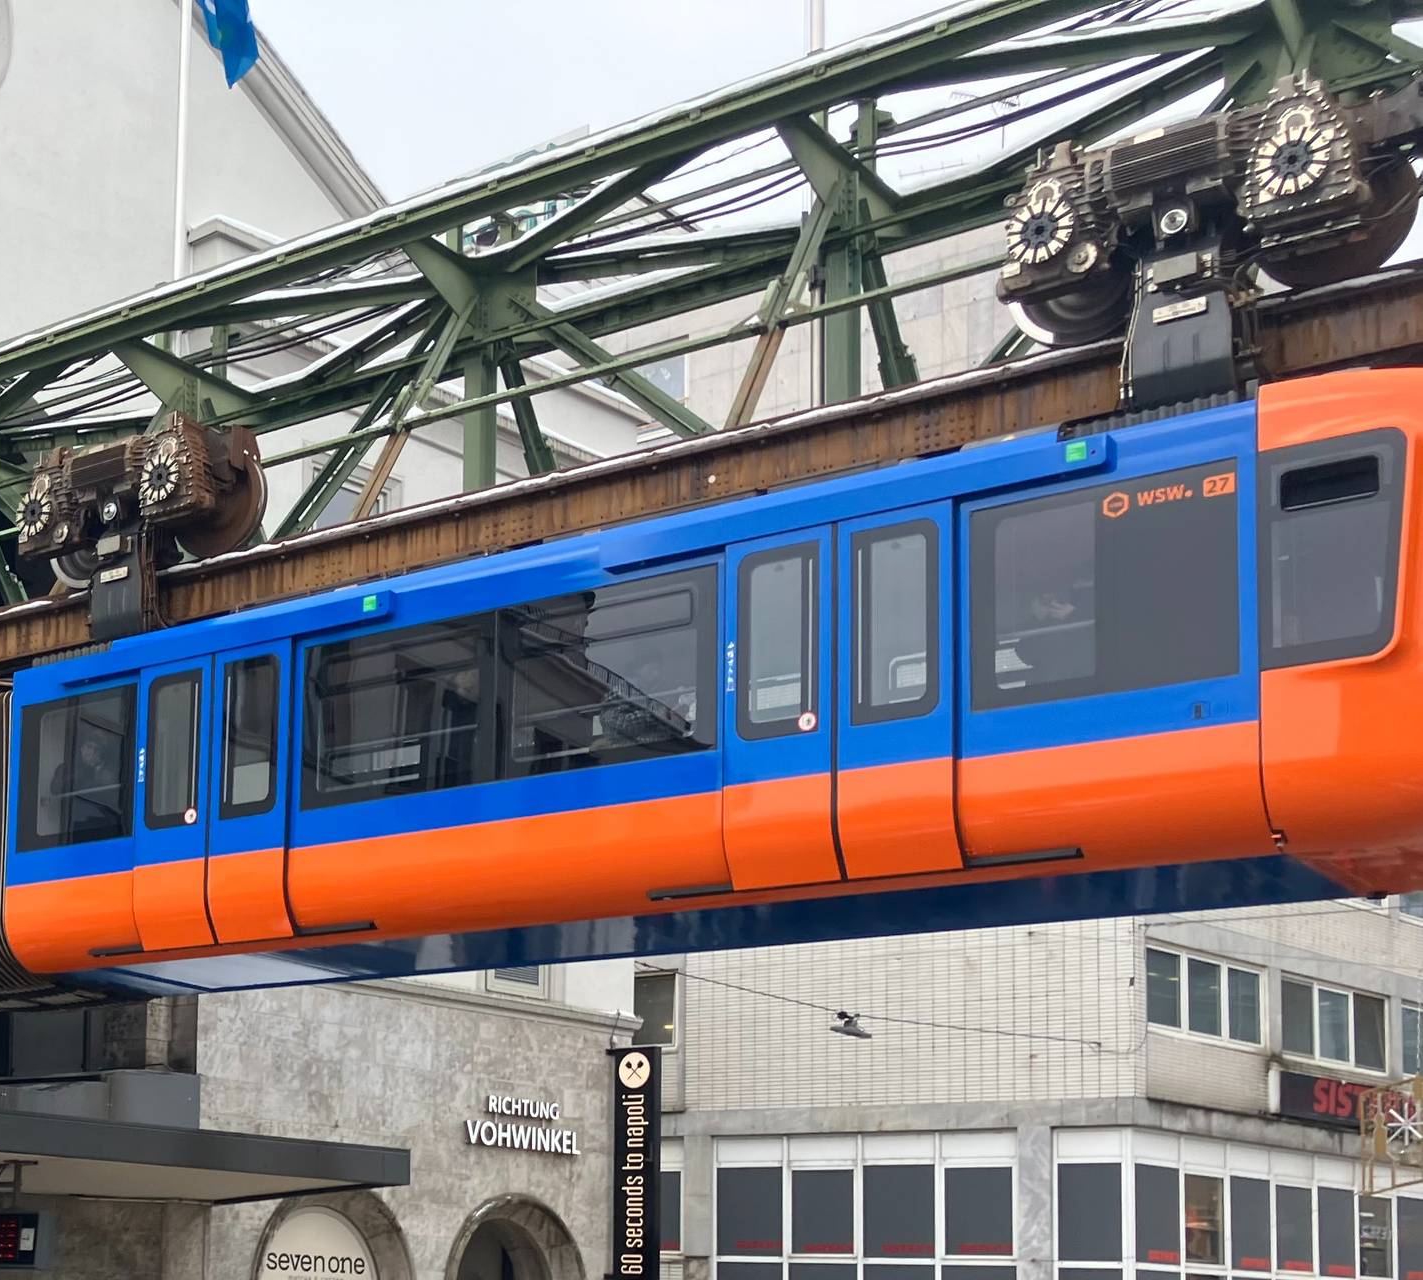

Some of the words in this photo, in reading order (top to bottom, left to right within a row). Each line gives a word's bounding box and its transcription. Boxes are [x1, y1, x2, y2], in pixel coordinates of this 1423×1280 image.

[1206, 477, 1230, 494] 27
[488, 1094, 560, 1120] RICHTUNG
[622, 1094, 649, 1148] napoli
[466, 1119, 581, 1155] VOHWINKEL
[621, 1153, 644, 1170] to
[621, 1175, 644, 1248] seconds
[621, 1253, 643, 1275] 60
